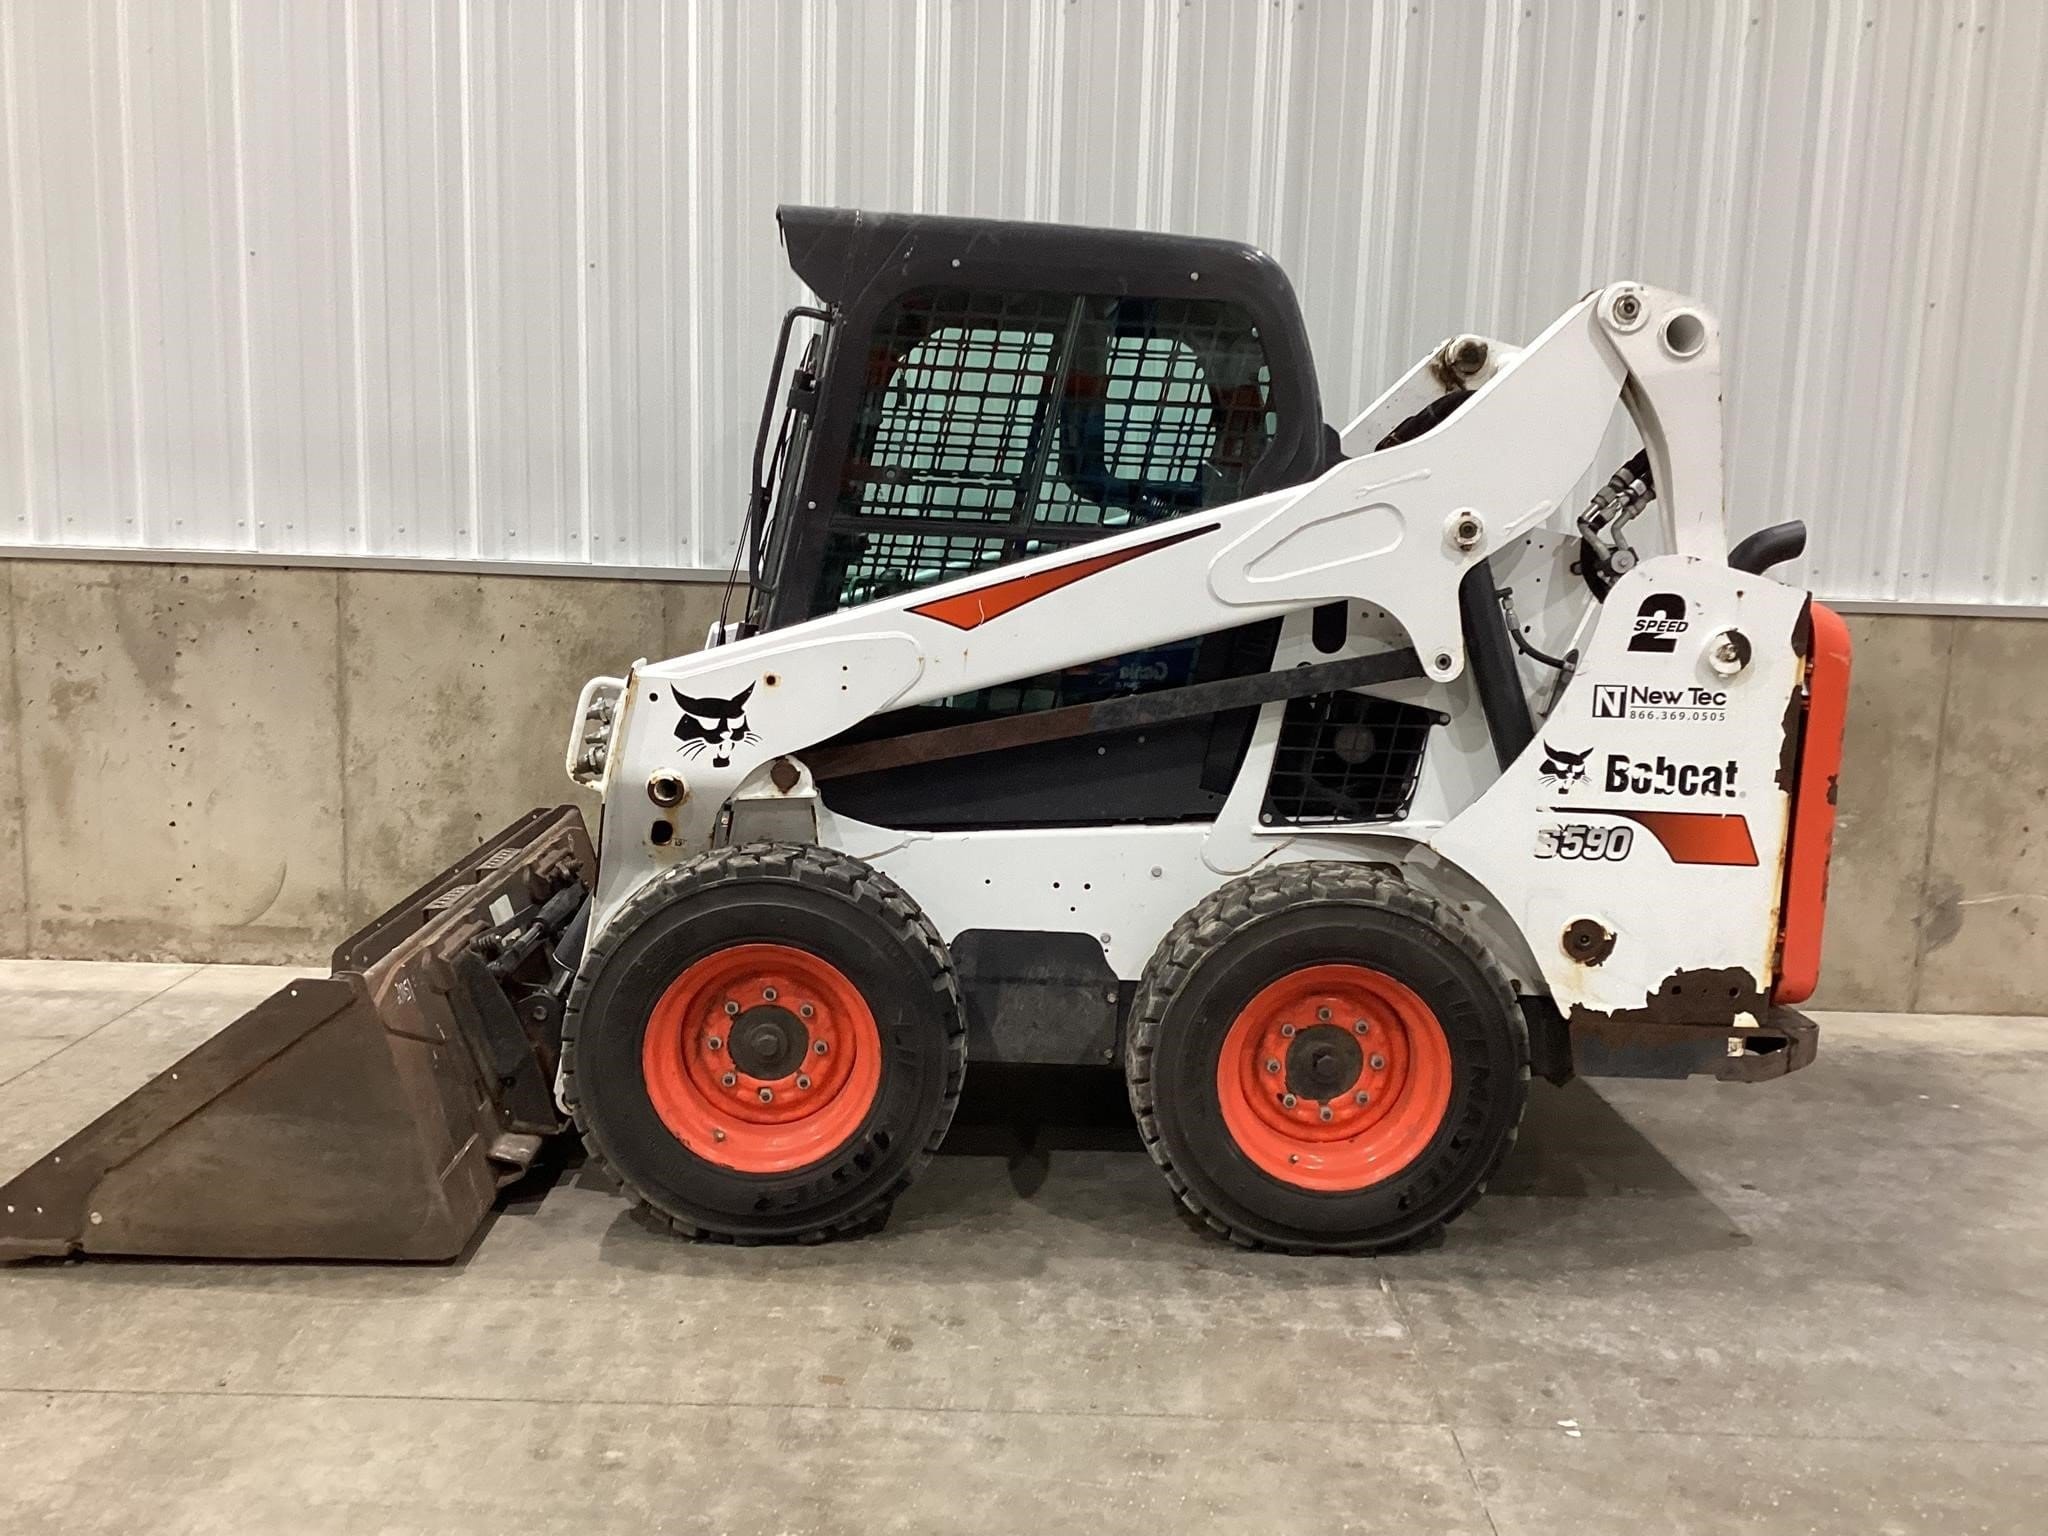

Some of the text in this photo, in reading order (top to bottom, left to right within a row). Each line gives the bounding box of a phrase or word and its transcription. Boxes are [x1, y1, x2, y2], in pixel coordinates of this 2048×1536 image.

[1627, 593, 1686, 653] 2
[1633, 620, 1688, 633] SPEED
[1631, 686, 1727, 705] New Tec
[1630, 710, 1726, 721] 866.369.0505
[1605, 754, 1738, 797] Bobcat
[1534, 825, 1634, 862] S590
